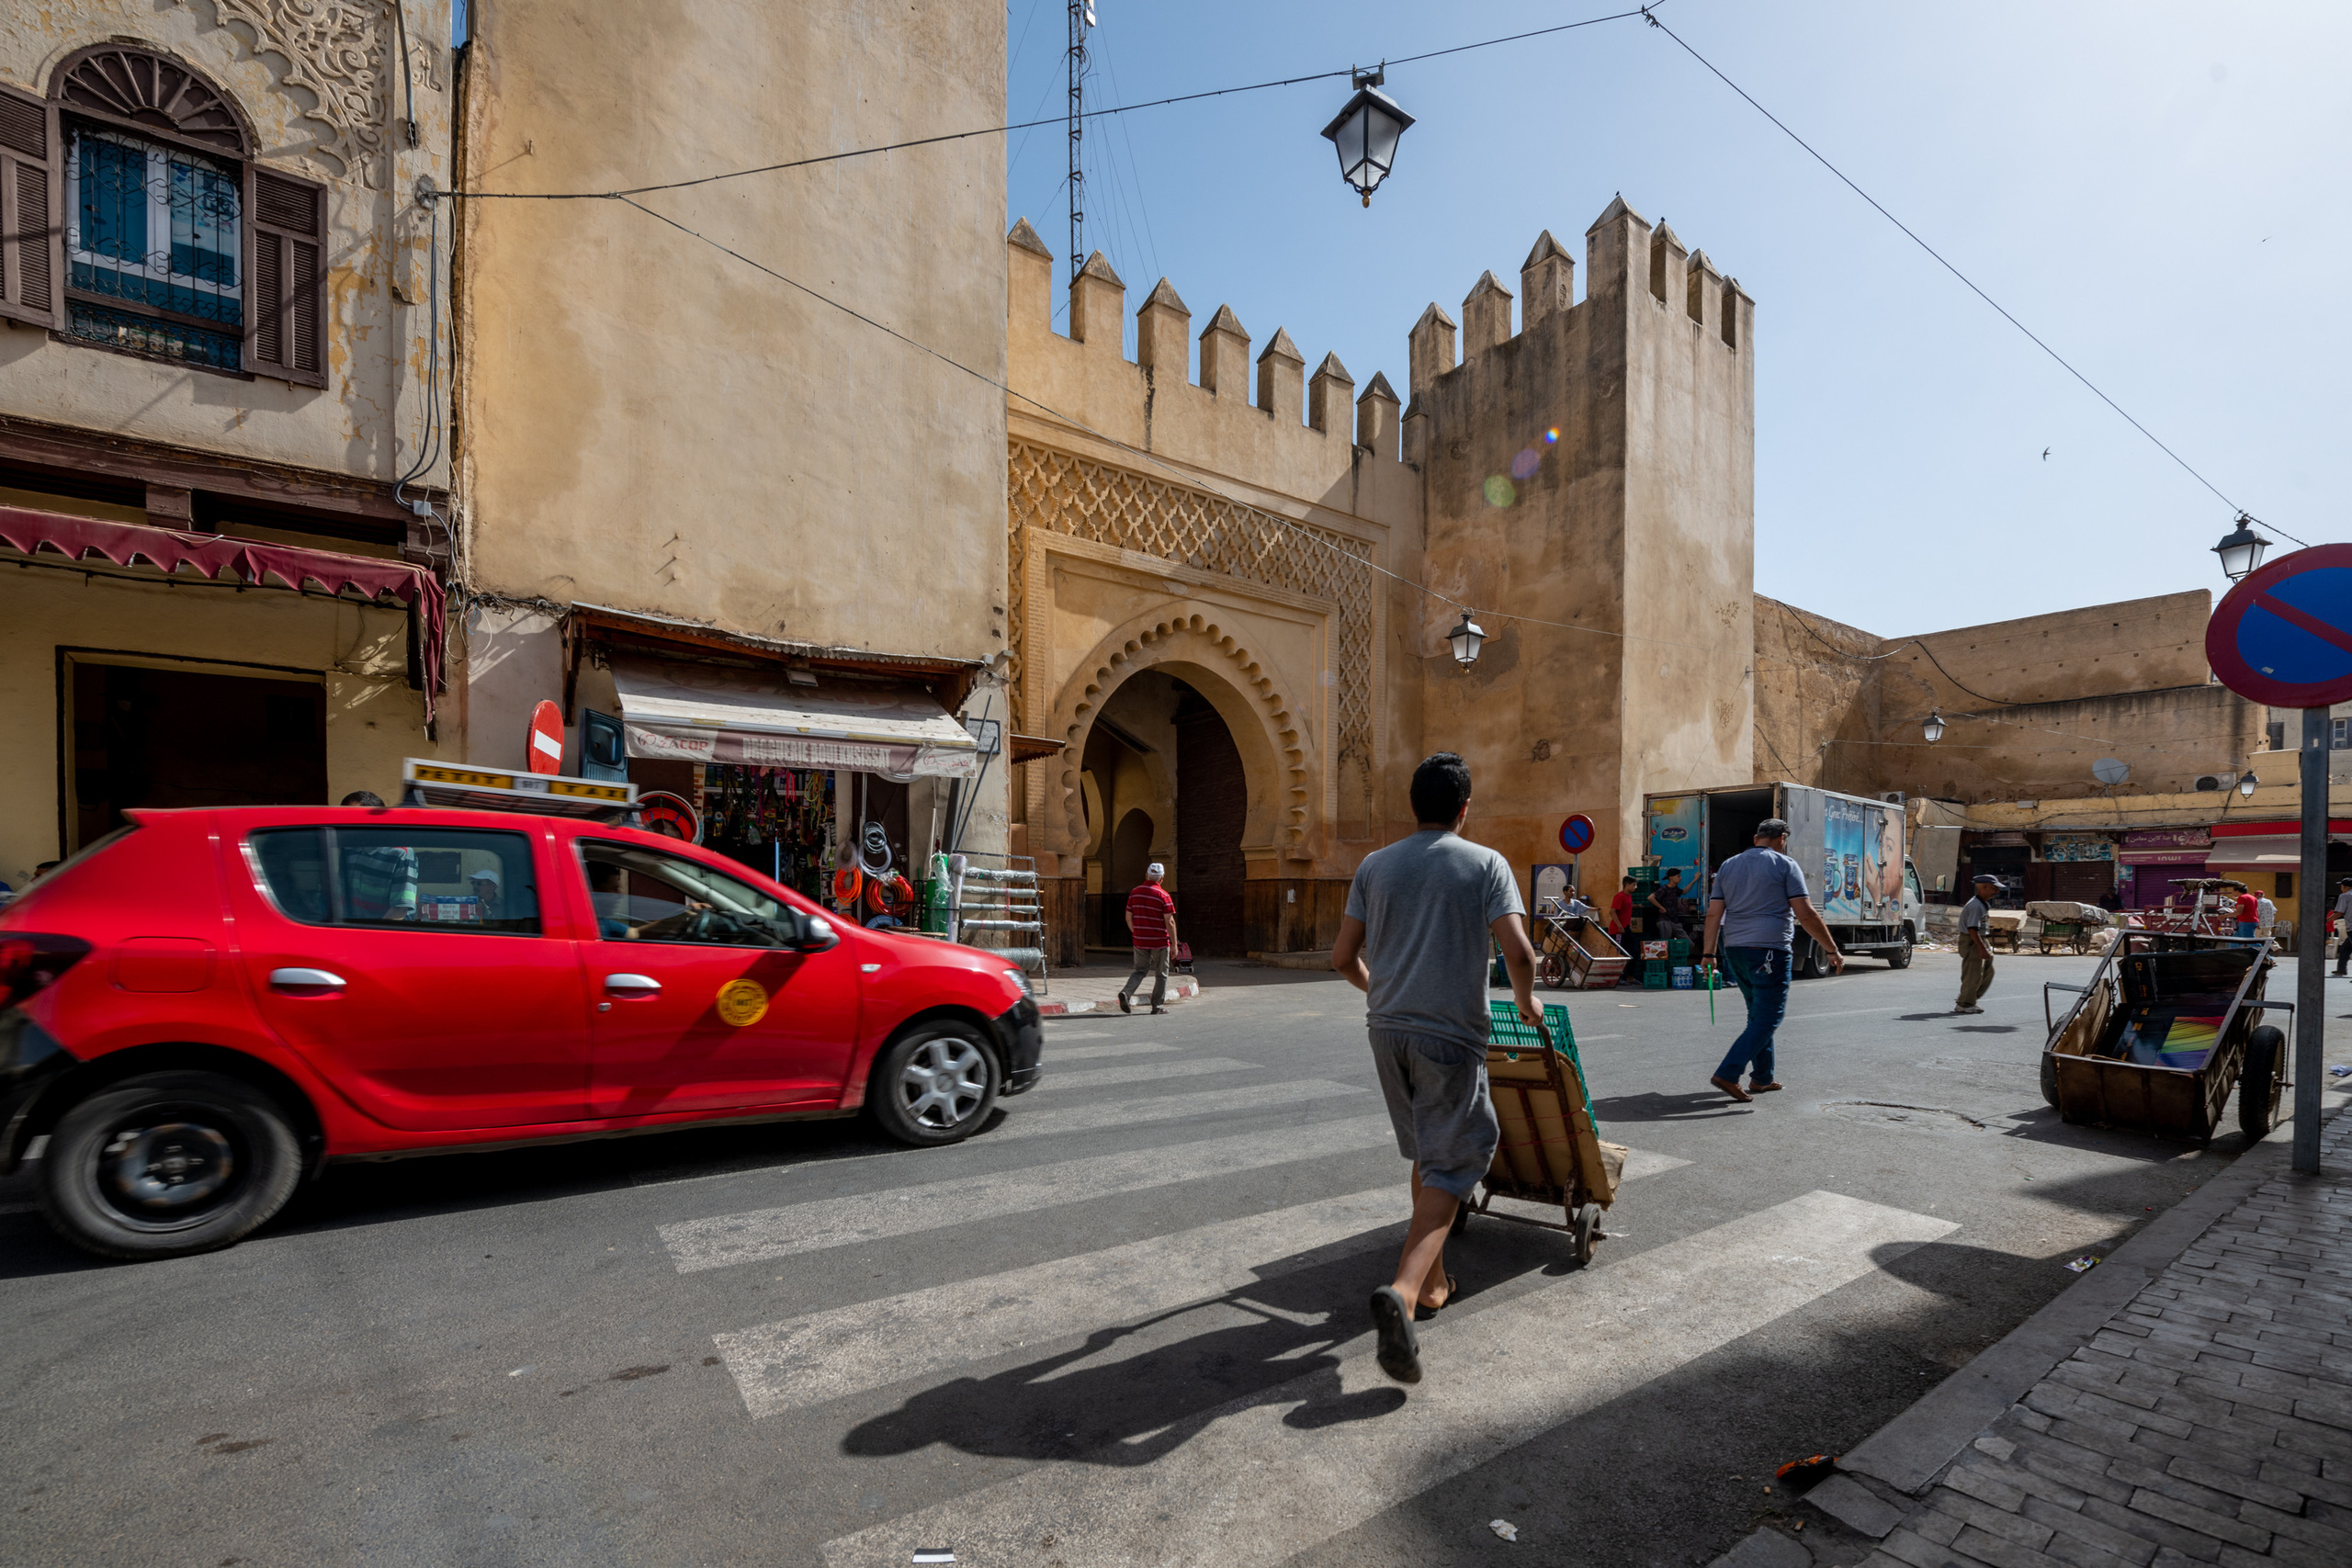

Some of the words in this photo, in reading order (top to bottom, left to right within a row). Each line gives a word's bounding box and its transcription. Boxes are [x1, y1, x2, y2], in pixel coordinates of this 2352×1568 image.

[742, 738, 809, 761] DROGUERIE
[812, 742, 891, 768] BOULKHSISSAT
[418, 769, 499, 784] PETIT
[563, 784, 628, 801] TAXI
[1827, 805, 1841, 821] Grec
